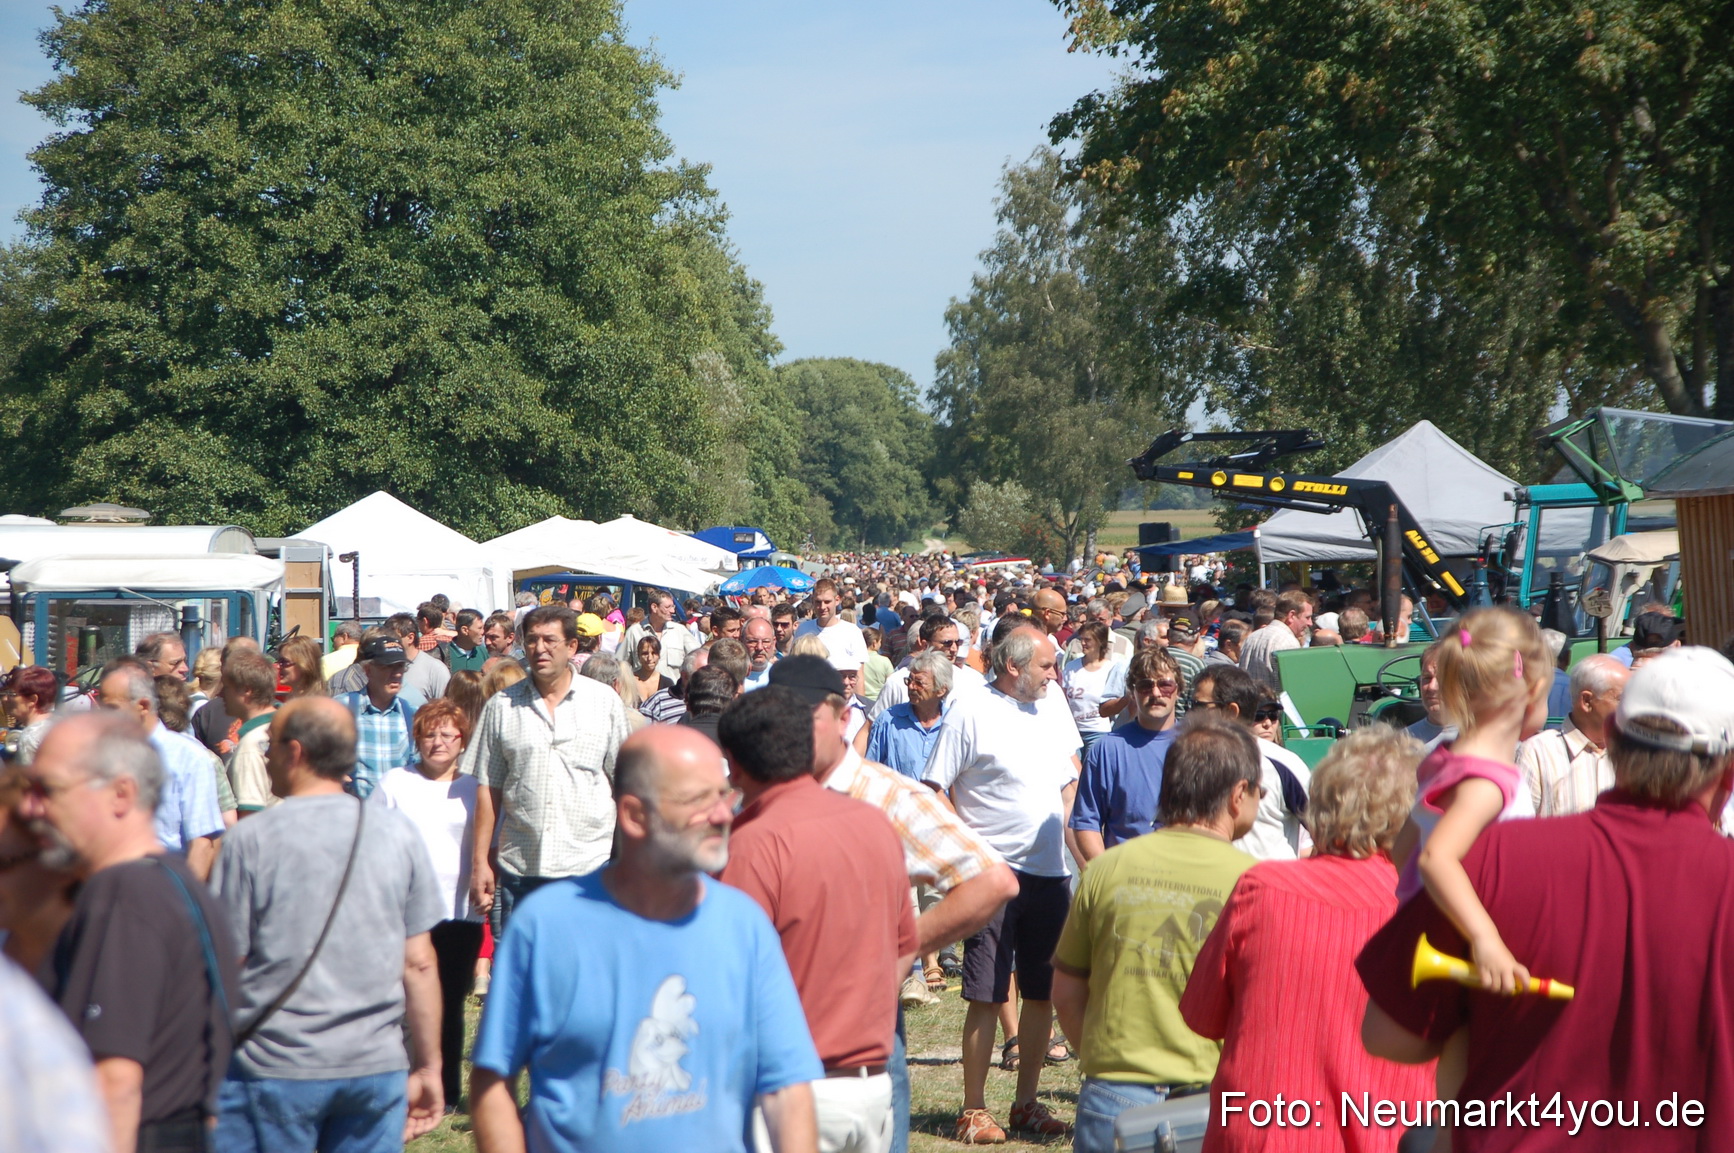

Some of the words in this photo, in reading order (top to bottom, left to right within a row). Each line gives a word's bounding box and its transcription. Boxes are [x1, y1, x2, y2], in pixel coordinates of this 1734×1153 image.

[1404, 529, 1428, 550] ALS
[1127, 875, 1151, 886] MEXX
[1153, 878, 1222, 898] INTERNATIONAL
[620, 1077, 708, 1127] Animal
